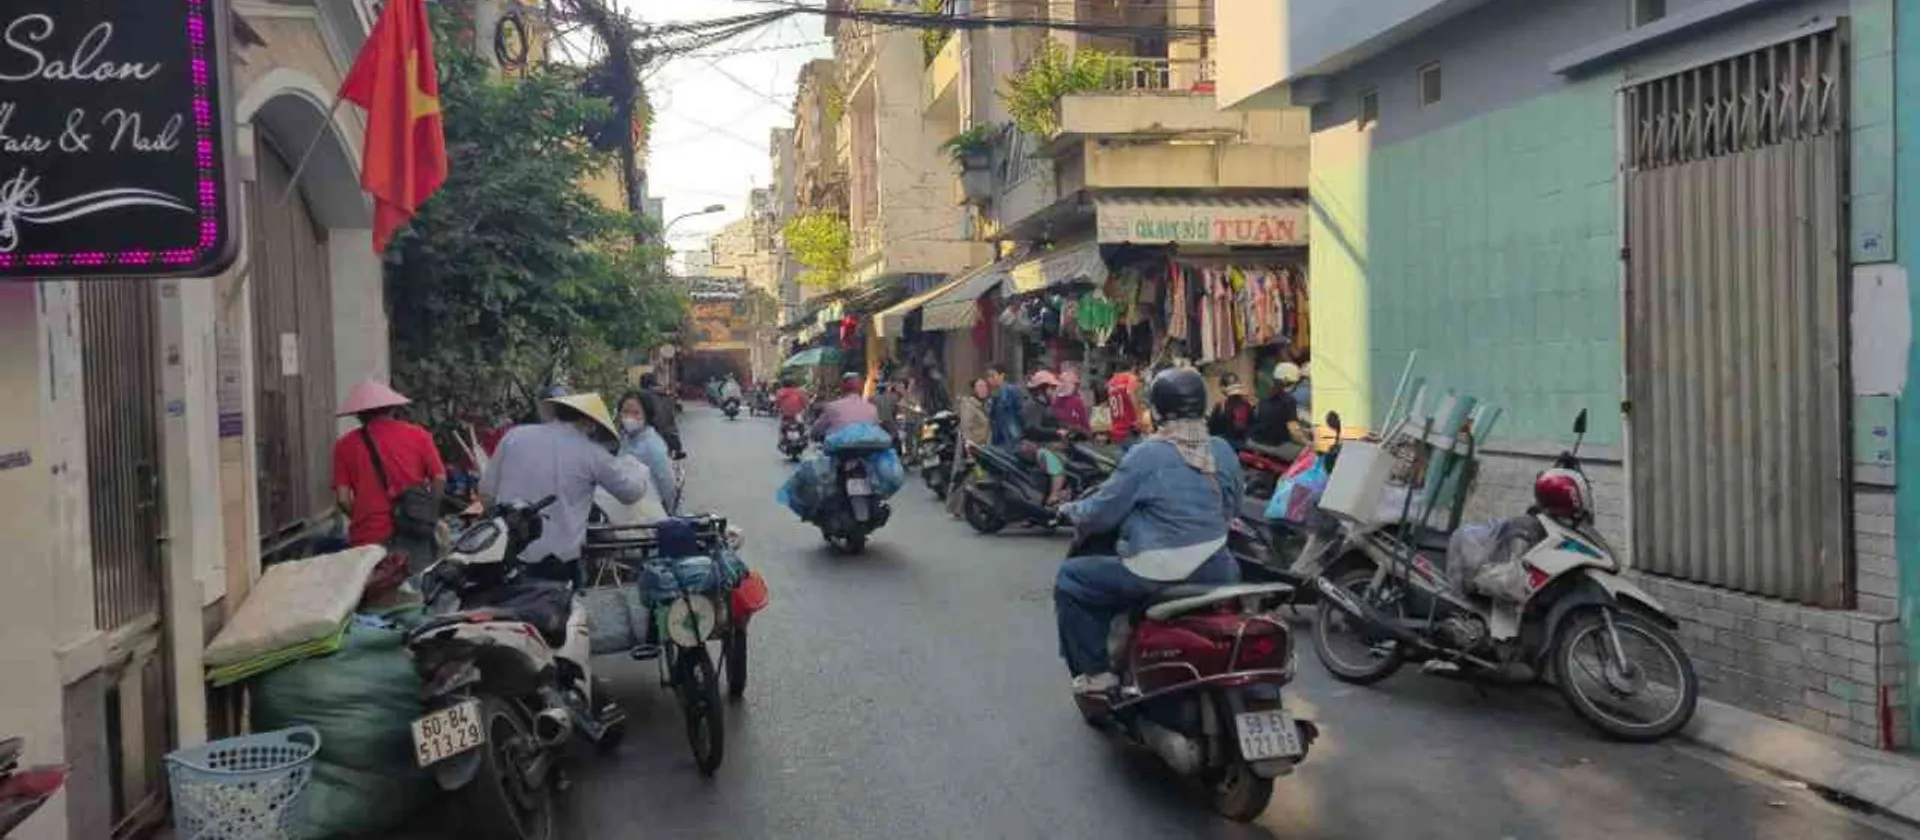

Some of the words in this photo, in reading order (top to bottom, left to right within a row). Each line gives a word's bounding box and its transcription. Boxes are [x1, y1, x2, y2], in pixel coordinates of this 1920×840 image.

[0, 13, 161, 81] Salon
[59, 108, 91, 151] &
[101, 108, 183, 151] Nail
